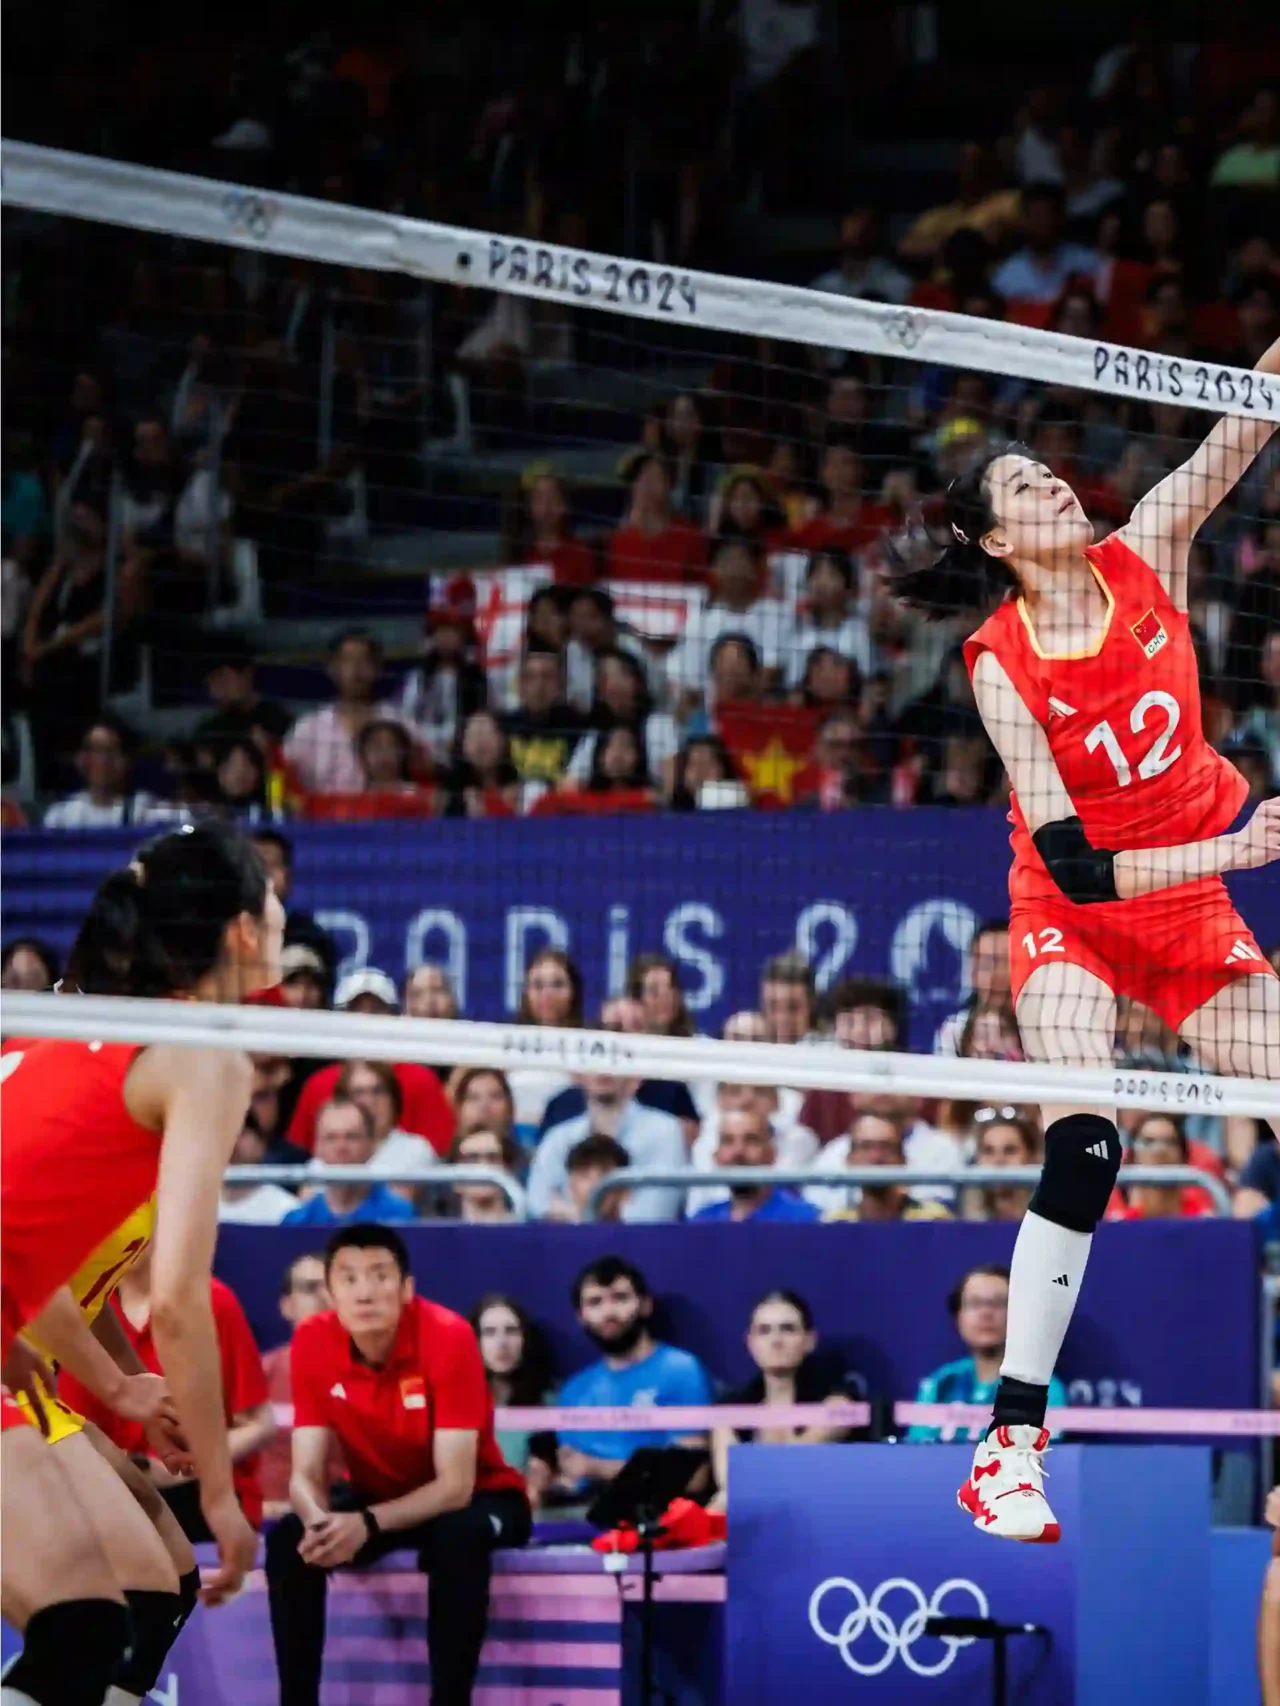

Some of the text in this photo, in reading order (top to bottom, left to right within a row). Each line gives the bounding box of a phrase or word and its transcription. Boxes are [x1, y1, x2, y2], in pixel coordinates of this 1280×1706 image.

[603, 263, 697, 314] 2024
[1194, 367, 1275, 411] 2024
[1147, 632, 1167, 655] CHN
[1084, 690, 1183, 787] 12
[1022, 926, 1066, 959] 12
